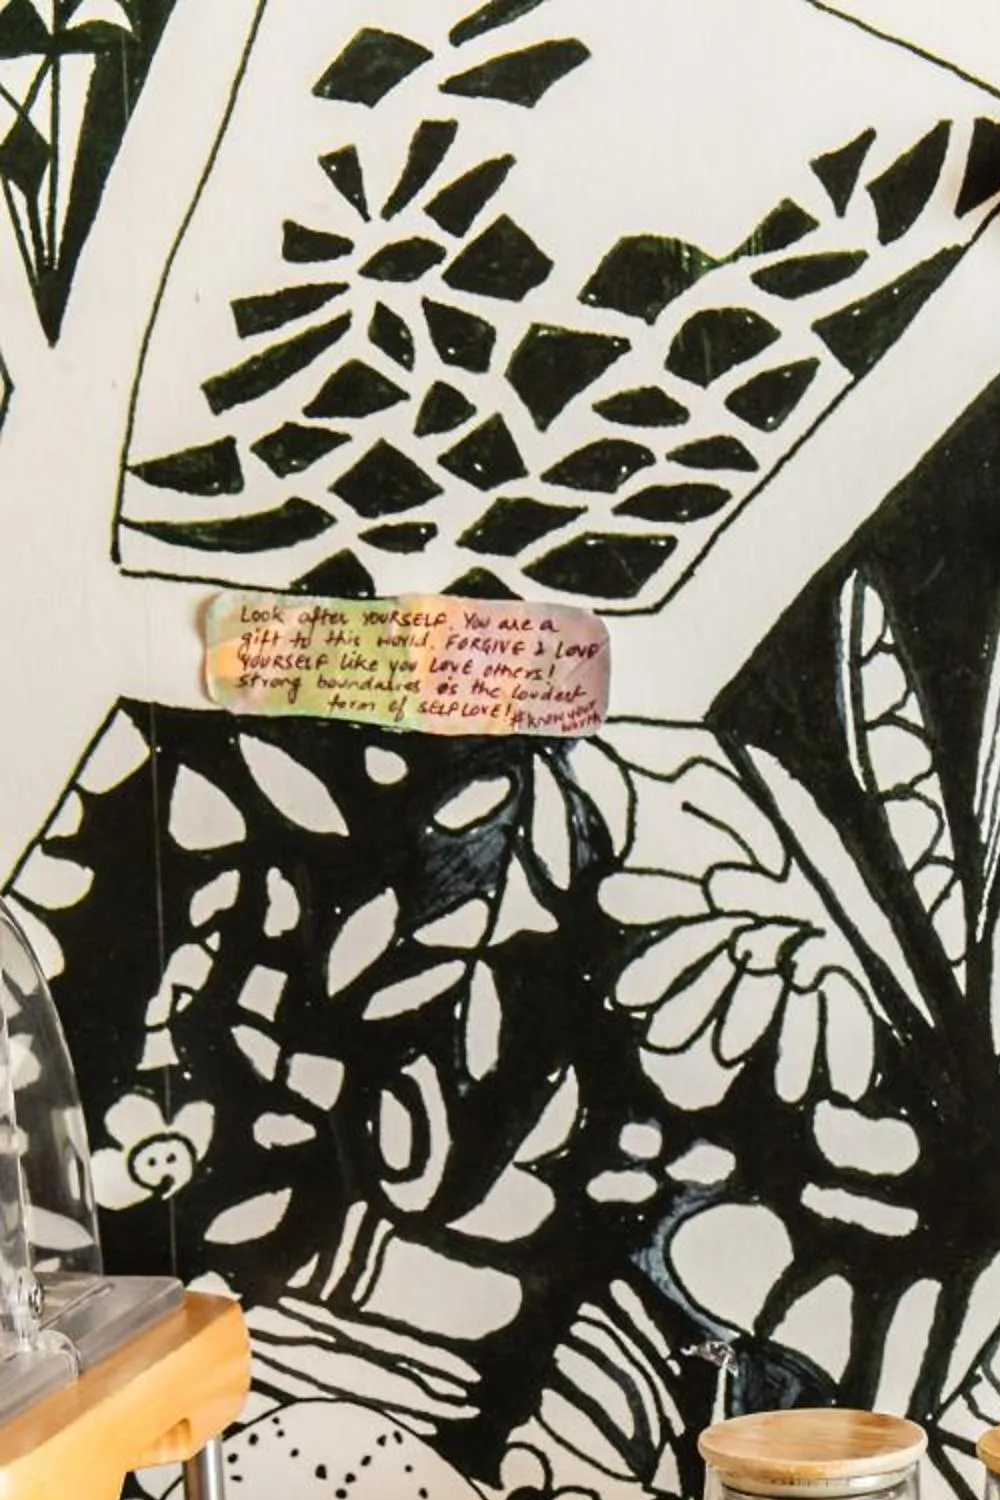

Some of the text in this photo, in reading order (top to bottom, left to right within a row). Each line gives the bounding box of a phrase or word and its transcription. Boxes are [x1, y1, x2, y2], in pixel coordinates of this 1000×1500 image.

[240, 605, 284, 624] Look
[298, 605, 349, 636] after
[539, 618, 559, 632] a
[238, 627, 282, 654] gift
[289, 631, 312, 649] to
[325, 628, 361, 646] this
[445, 634, 526, 656] FORGIVE
[389, 658, 419, 690] you
[471, 678, 501, 698] the
[388, 696, 408, 722] of
